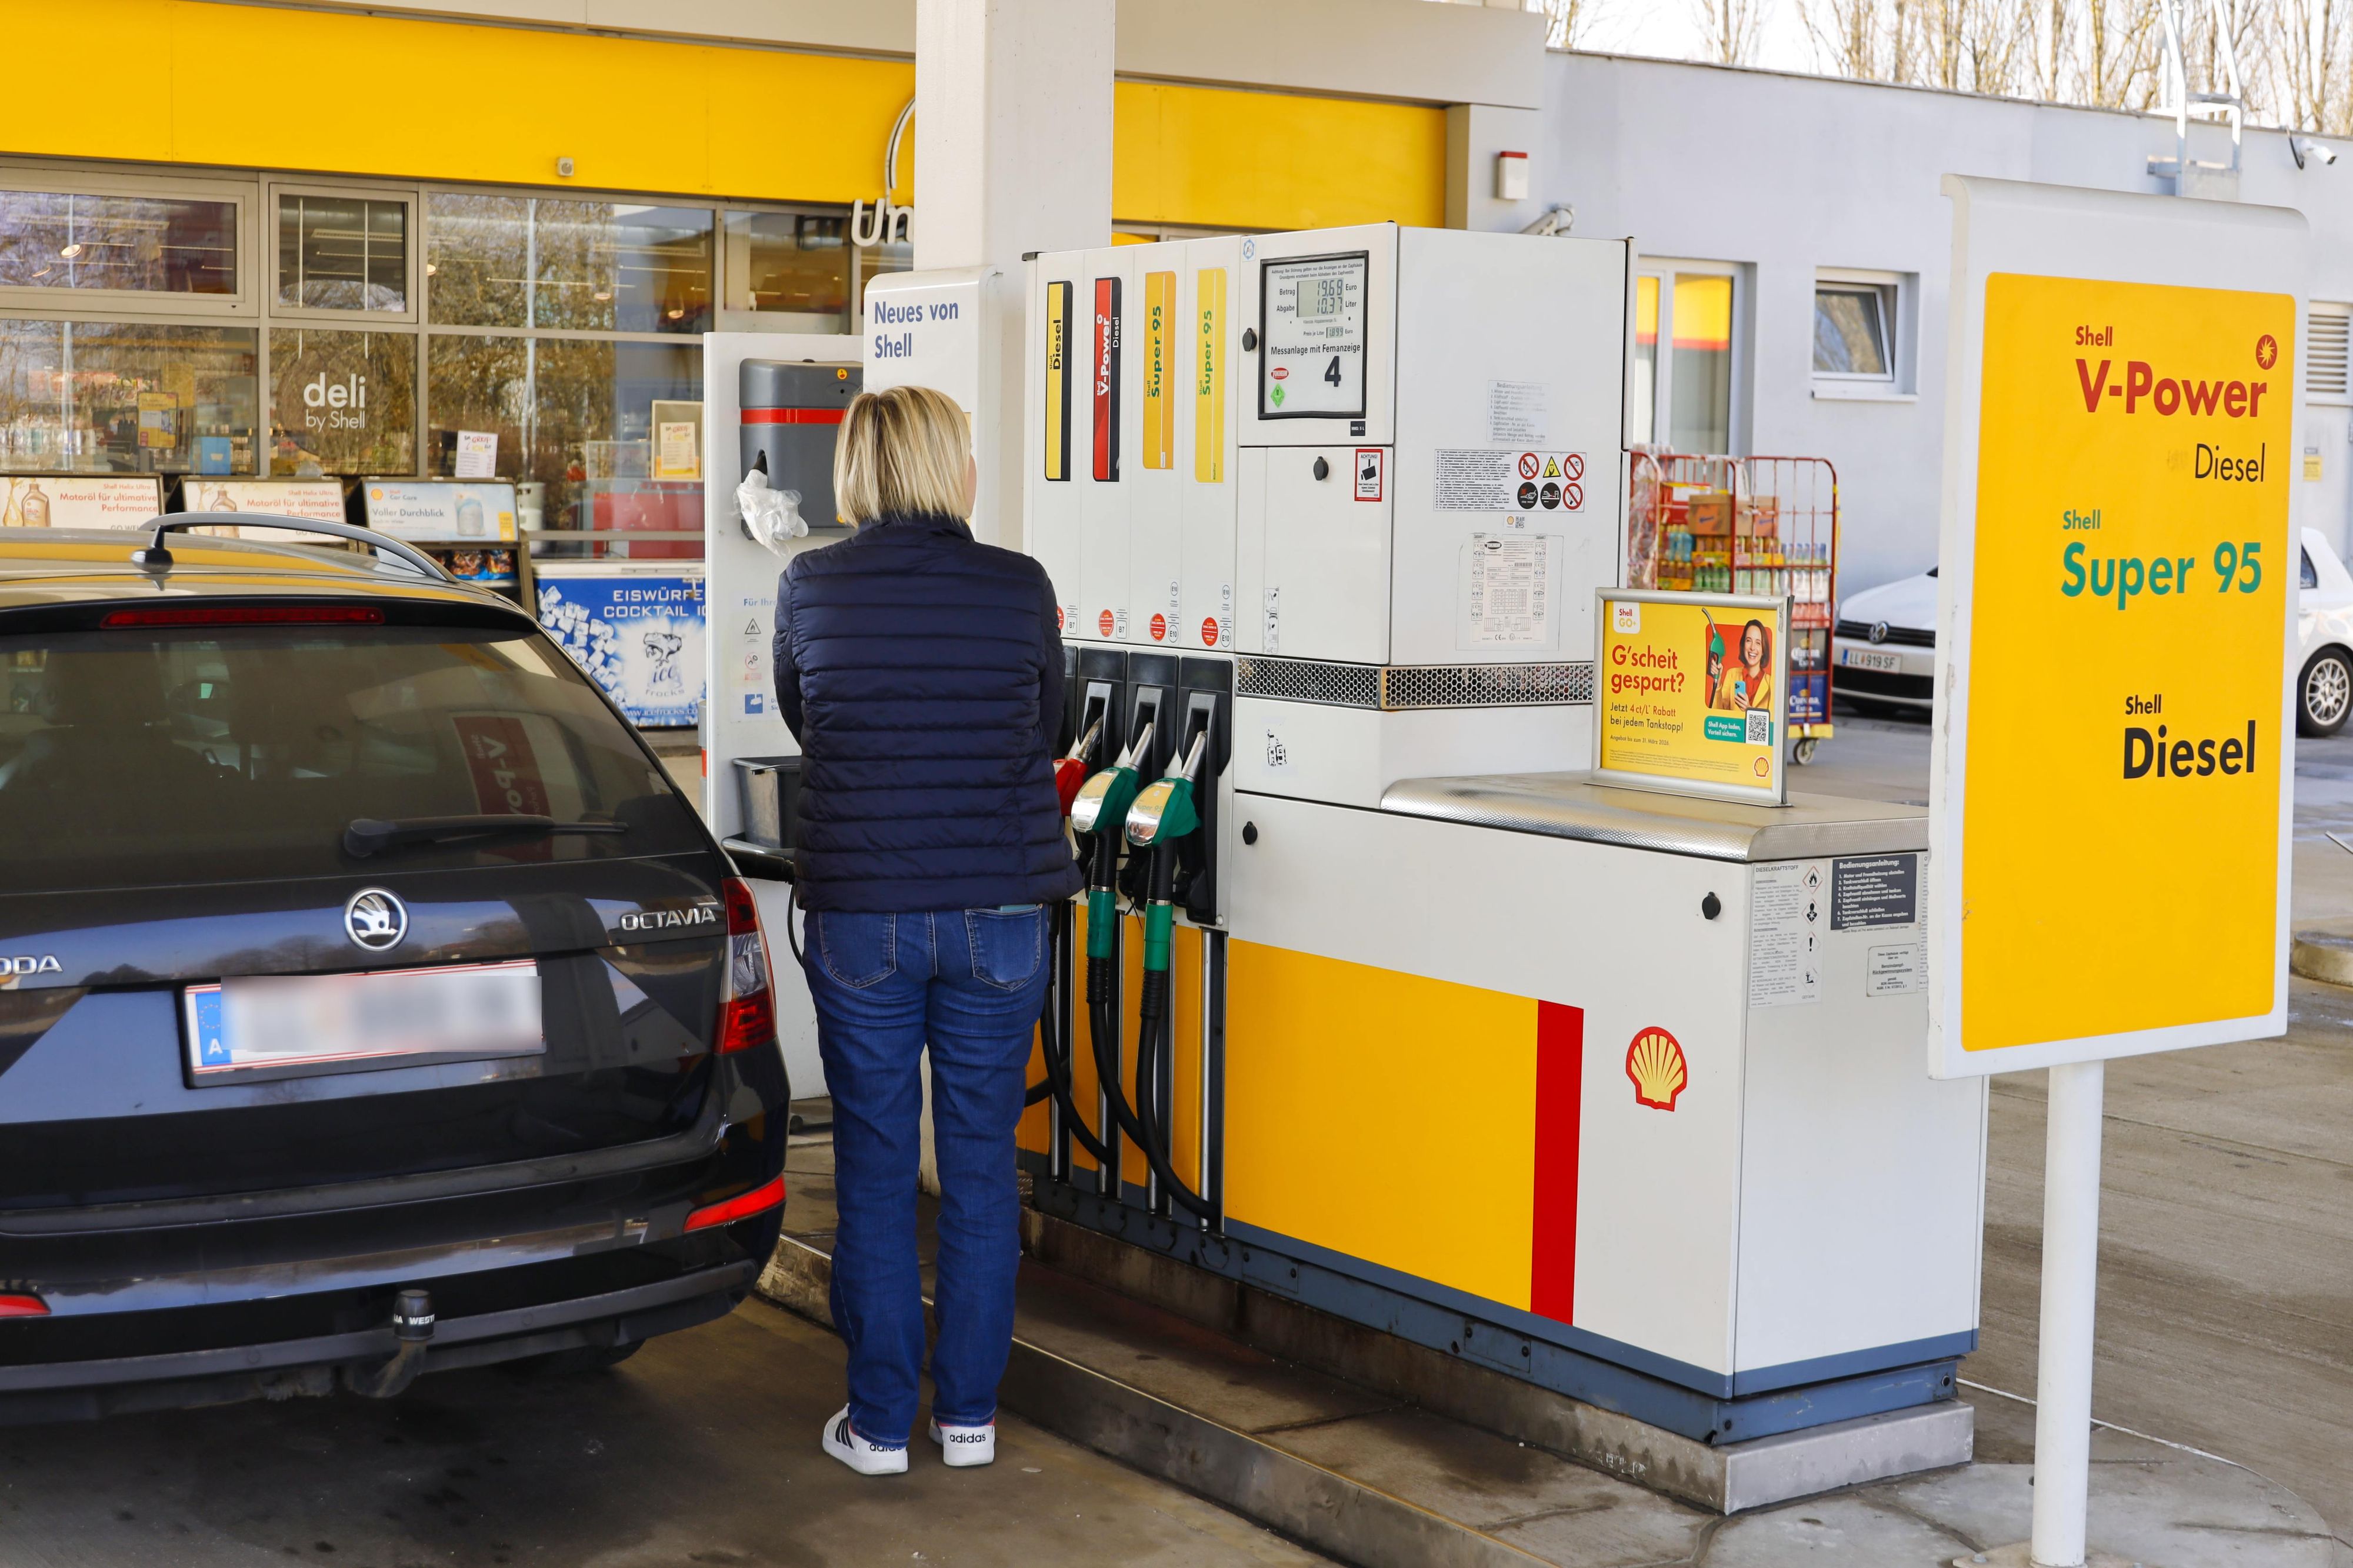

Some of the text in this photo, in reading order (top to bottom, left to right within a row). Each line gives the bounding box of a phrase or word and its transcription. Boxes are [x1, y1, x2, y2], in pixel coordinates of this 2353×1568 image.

[875, 301, 958, 324] Neues von
[1277, 305, 1295, 313] Abgabe
[1317, 296, 1343, 315] 10,37
[875, 333, 912, 358] Shell
[1053, 319, 1061, 370] Diesel
[2075, 325, 2113, 346] Shell
[1100, 318, 1110, 396] V-Power
[1151, 306, 1162, 398] Super 95
[1202, 311, 1213, 395] Super 95
[1271, 343, 1361, 356] Messanlage mit Fernanzeige
[1324, 356, 1341, 387] 4
[304, 372, 366, 408] deli
[2075, 358, 2267, 418] V-Power
[306, 409, 365, 433] by Shell
[2195, 442, 2265, 482] Diesel
[60, 492, 157, 502] Motoröl für ultimative
[247, 498, 339, 508] Motoröl für ultimative
[102, 504, 158, 512] Performance
[287, 510, 341, 518] Performance
[400, 509, 445, 517] Durchblick
[2062, 509, 2101, 529] Shell
[2061, 541, 2262, 610] Super 95
[604, 606, 689, 618] COCKTAIL
[744, 598, 758, 606] Für
[1849, 653, 1859, 665] LL
[1884, 656, 1895, 668] SF
[1611, 672, 1685, 696] gespart?
[1610, 702, 1628, 712] Jetzt
[1653, 706, 1676, 717] Rabatt
[2125, 694, 2161, 715] Shell
[1610, 715, 1684, 733] bei jedem Tankstopp!
[2123, 719, 2256, 779] Diesel
[1839, 859, 1899, 869] Bedienungsanleitung:
[621, 908, 716, 930] OCTAVIA
[208, 1037, 223, 1056] A
[949, 1433, 986, 1443] adidas
